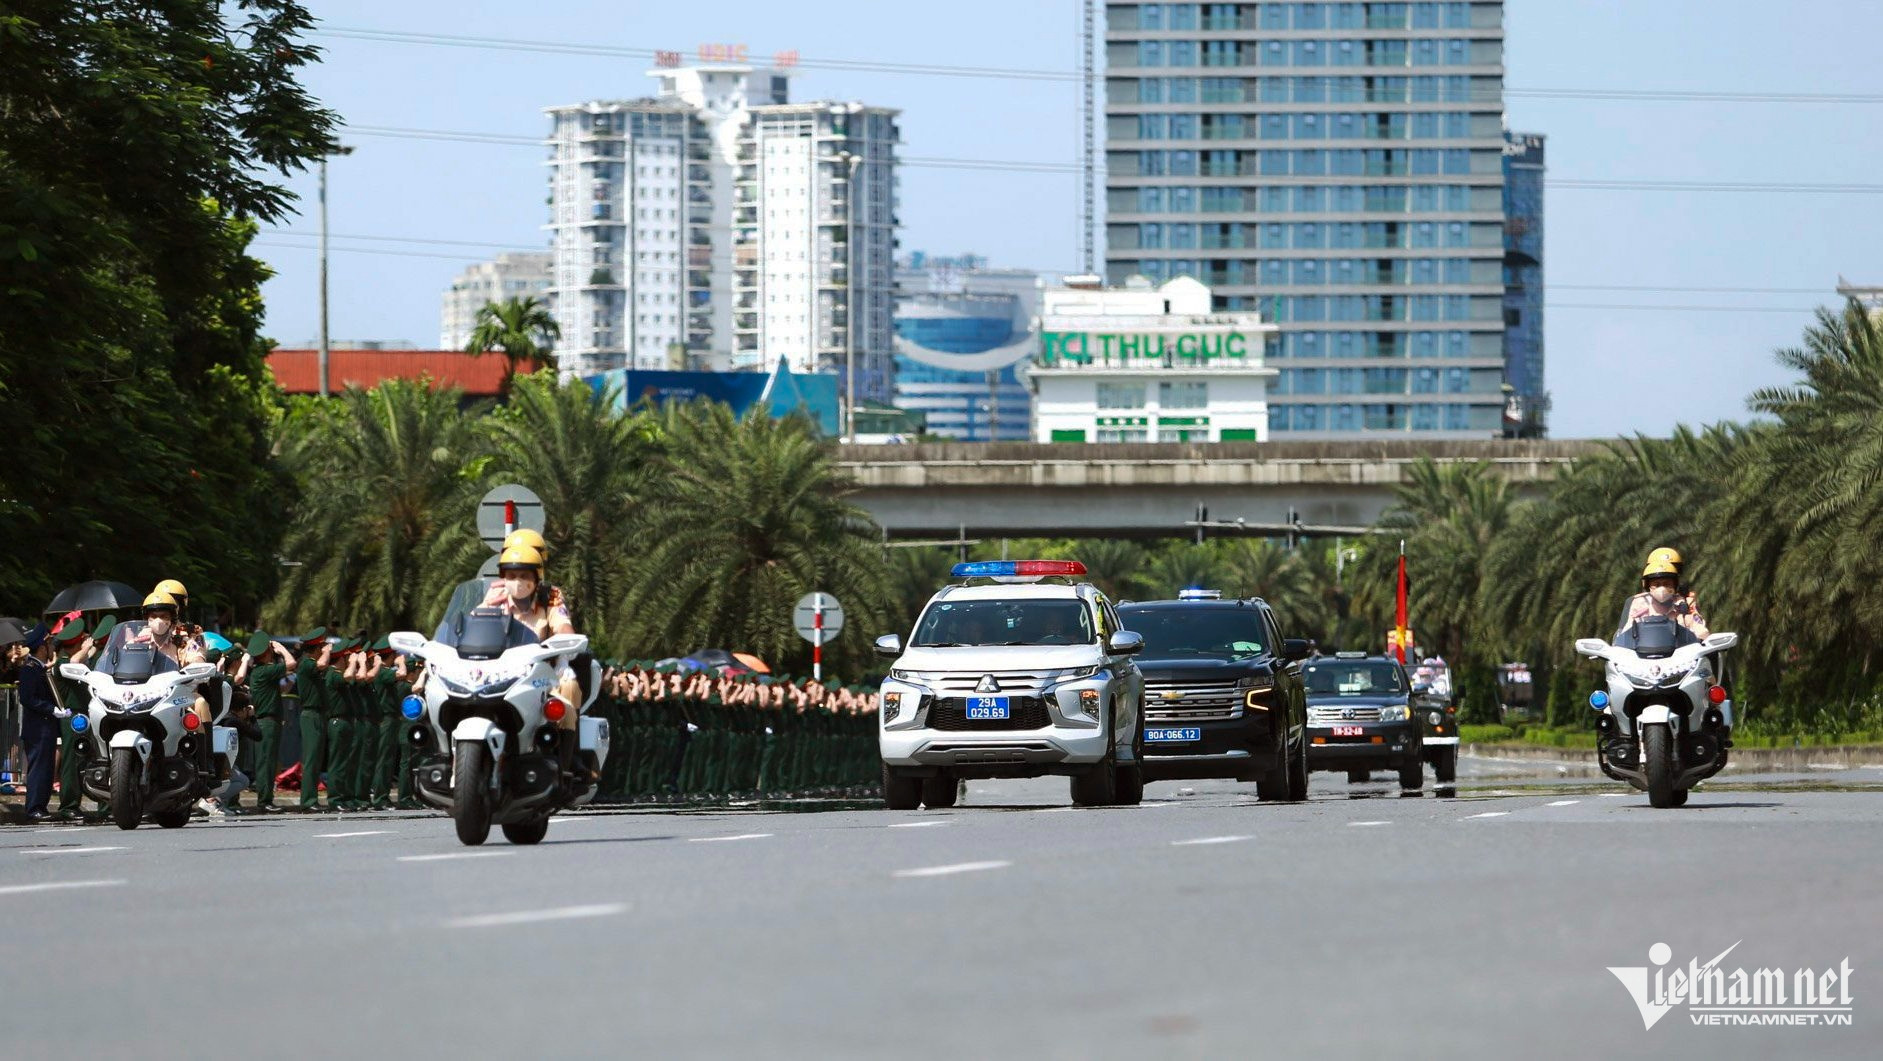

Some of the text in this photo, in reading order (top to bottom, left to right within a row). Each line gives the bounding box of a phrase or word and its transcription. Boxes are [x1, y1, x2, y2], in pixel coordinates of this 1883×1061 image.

[978, 698, 997, 708] 29A
[970, 707, 1005, 718] 029.69
[1148, 730, 1196, 740] 80A-066.12
